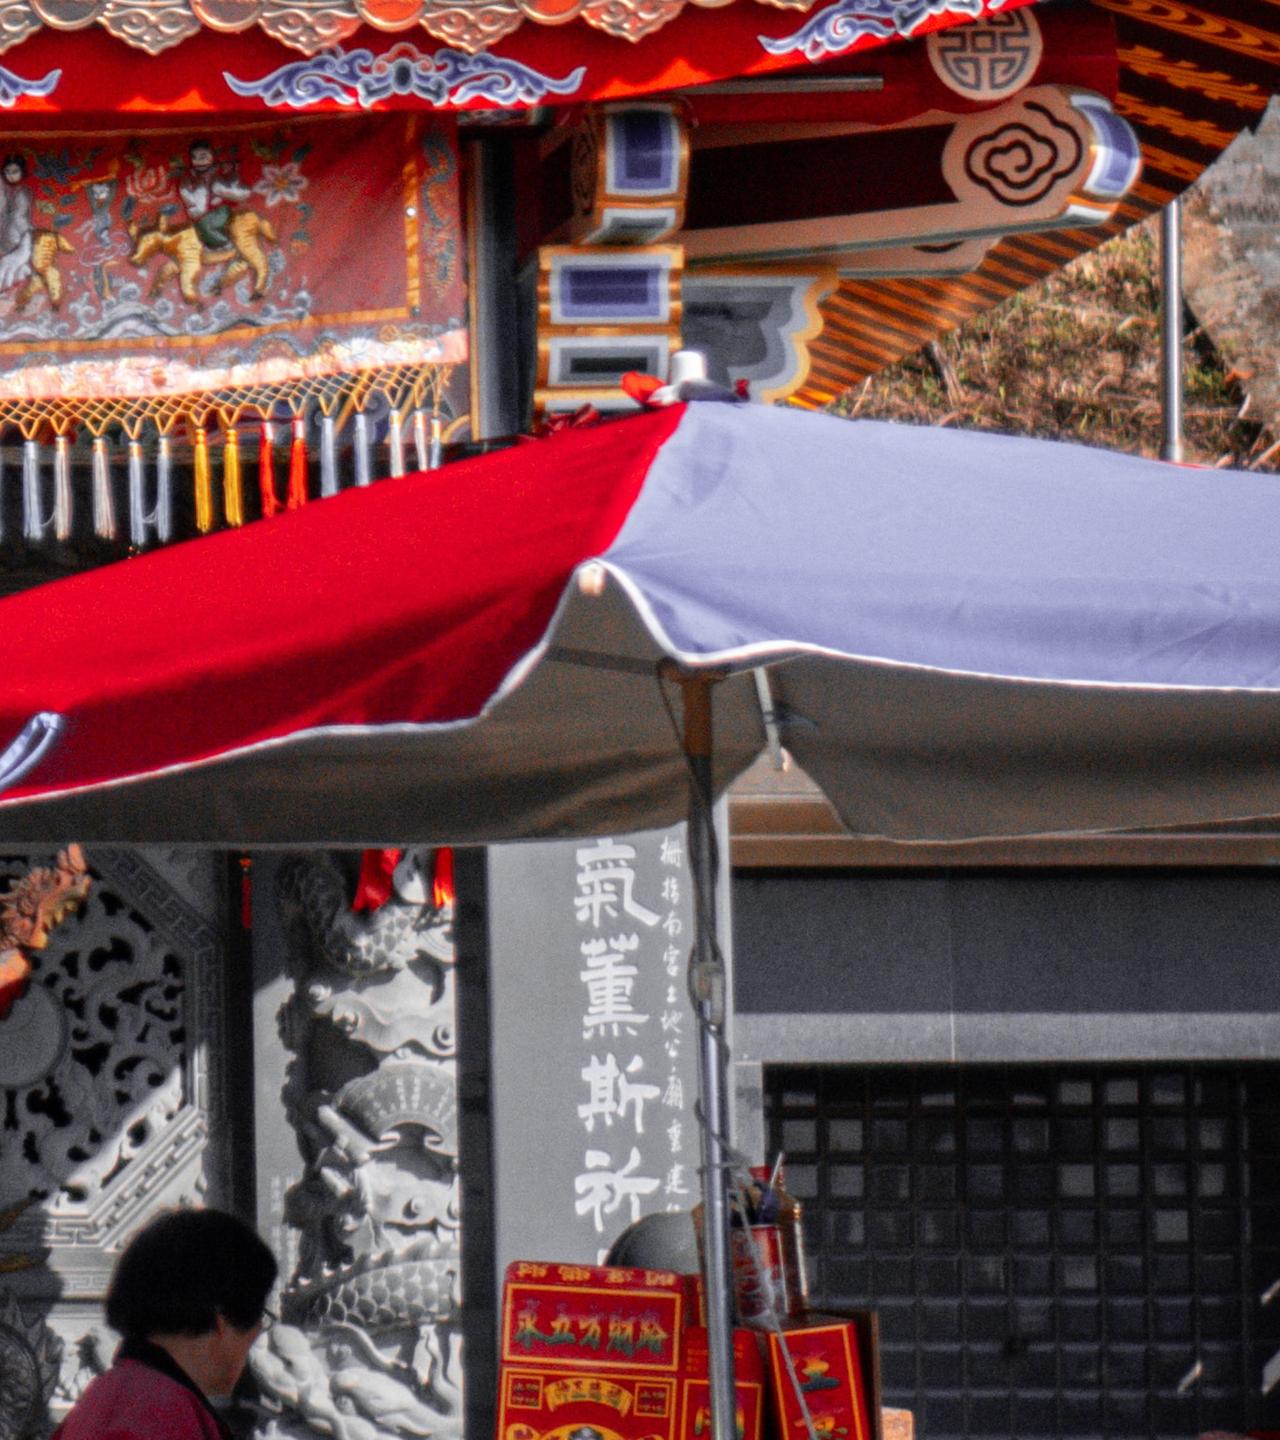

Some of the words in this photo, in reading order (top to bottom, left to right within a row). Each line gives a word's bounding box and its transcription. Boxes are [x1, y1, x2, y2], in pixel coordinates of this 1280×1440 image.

[574, 838, 661, 1266] 氣薰斯祈
[660, 835, 689, 1211] 柵指南宮土地公廟重建
